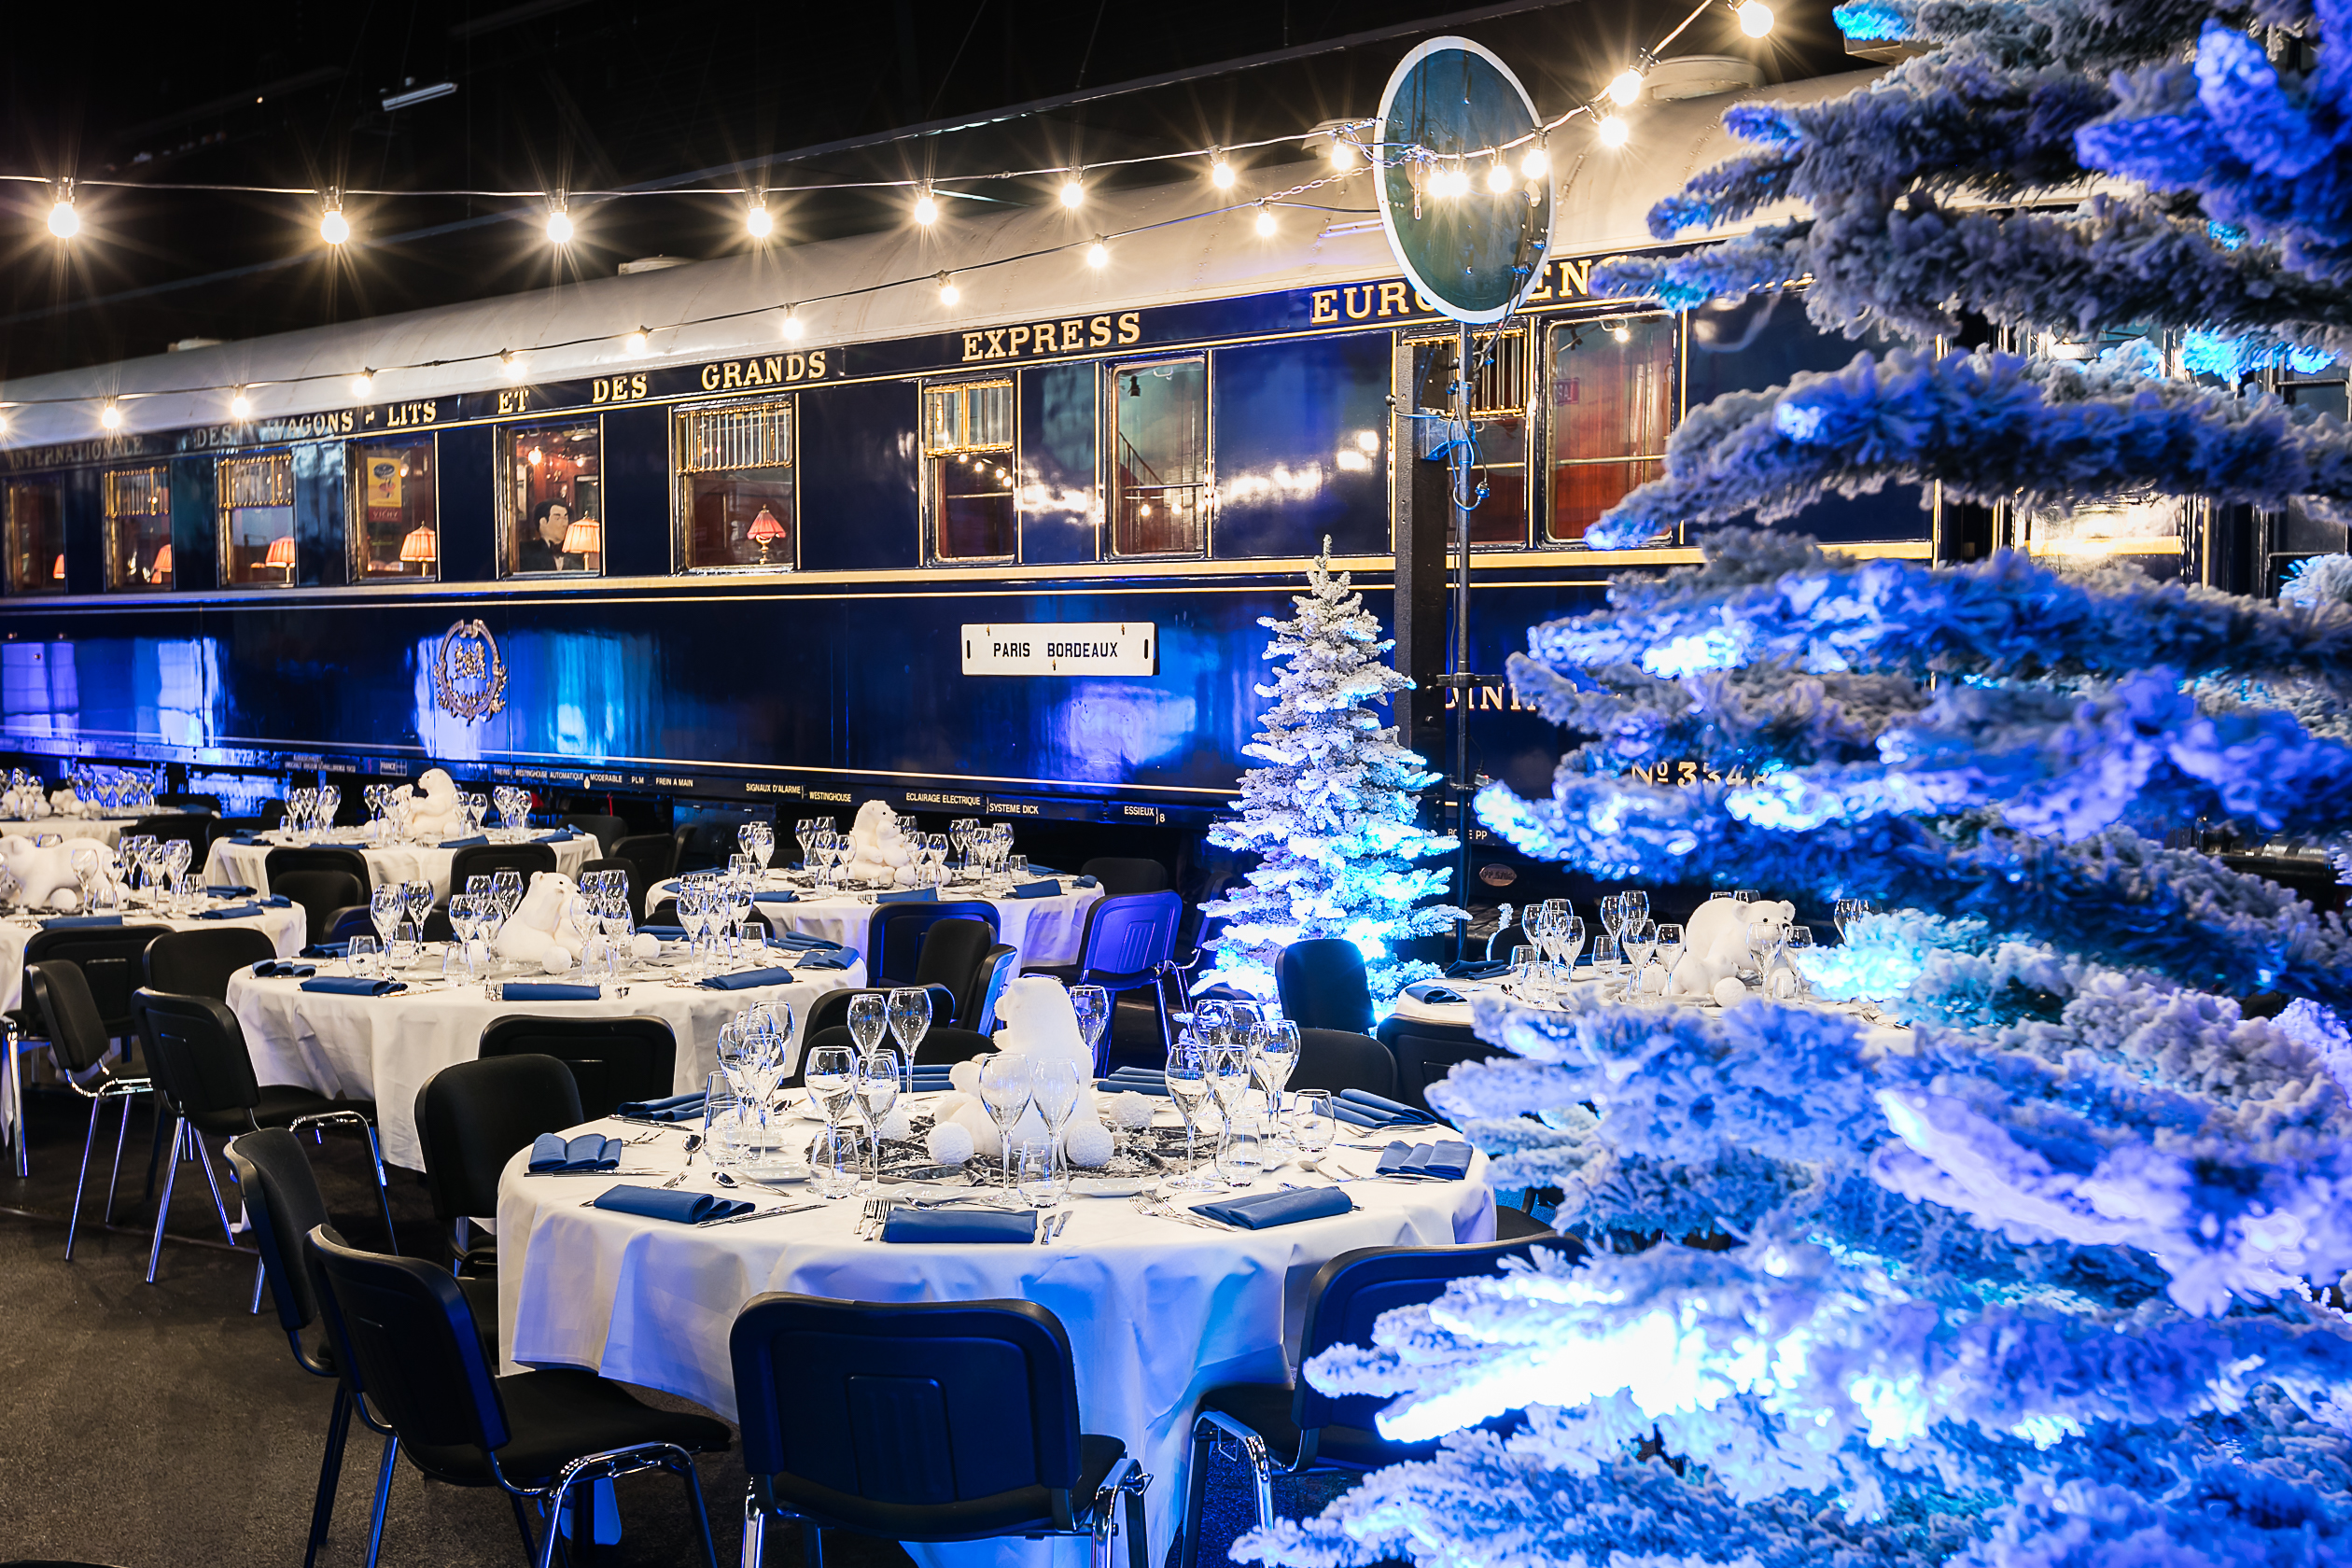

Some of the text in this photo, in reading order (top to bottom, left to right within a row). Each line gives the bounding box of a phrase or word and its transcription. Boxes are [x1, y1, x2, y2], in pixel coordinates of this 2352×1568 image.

[196, 427, 231, 448] DES
[267, 411, 353, 441] WAGONS
[387, 399, 437, 428] LITS
[497, 389, 529, 414] ET
[592, 373, 648, 404] DES
[701, 350, 826, 391] GRANDS
[962, 312, 1141, 362] EXPRESS
[993, 642, 1118, 658] PARIS BORDEAUX
[550, 771, 584, 781] AUTOMATIQUE
[589, 773, 623, 784] MODERABLE
[631, 776, 645, 785] PLM
[655, 777, 672, 786] FREIN
[678, 777, 693, 788] MAIN
[746, 783, 801, 794] SIGNAUX D'ALARME
[809, 791, 852, 803] WESTINGHOUSE
[905, 792, 981, 806] ECLAIRAGE ELECTRIQUE
[988, 803, 1040, 815] SYSTEME DICK
[1124, 805, 1155, 818] ESSIEUX
[1159, 813, 1166, 823] 8
[1476, 830, 1488, 840] PP
